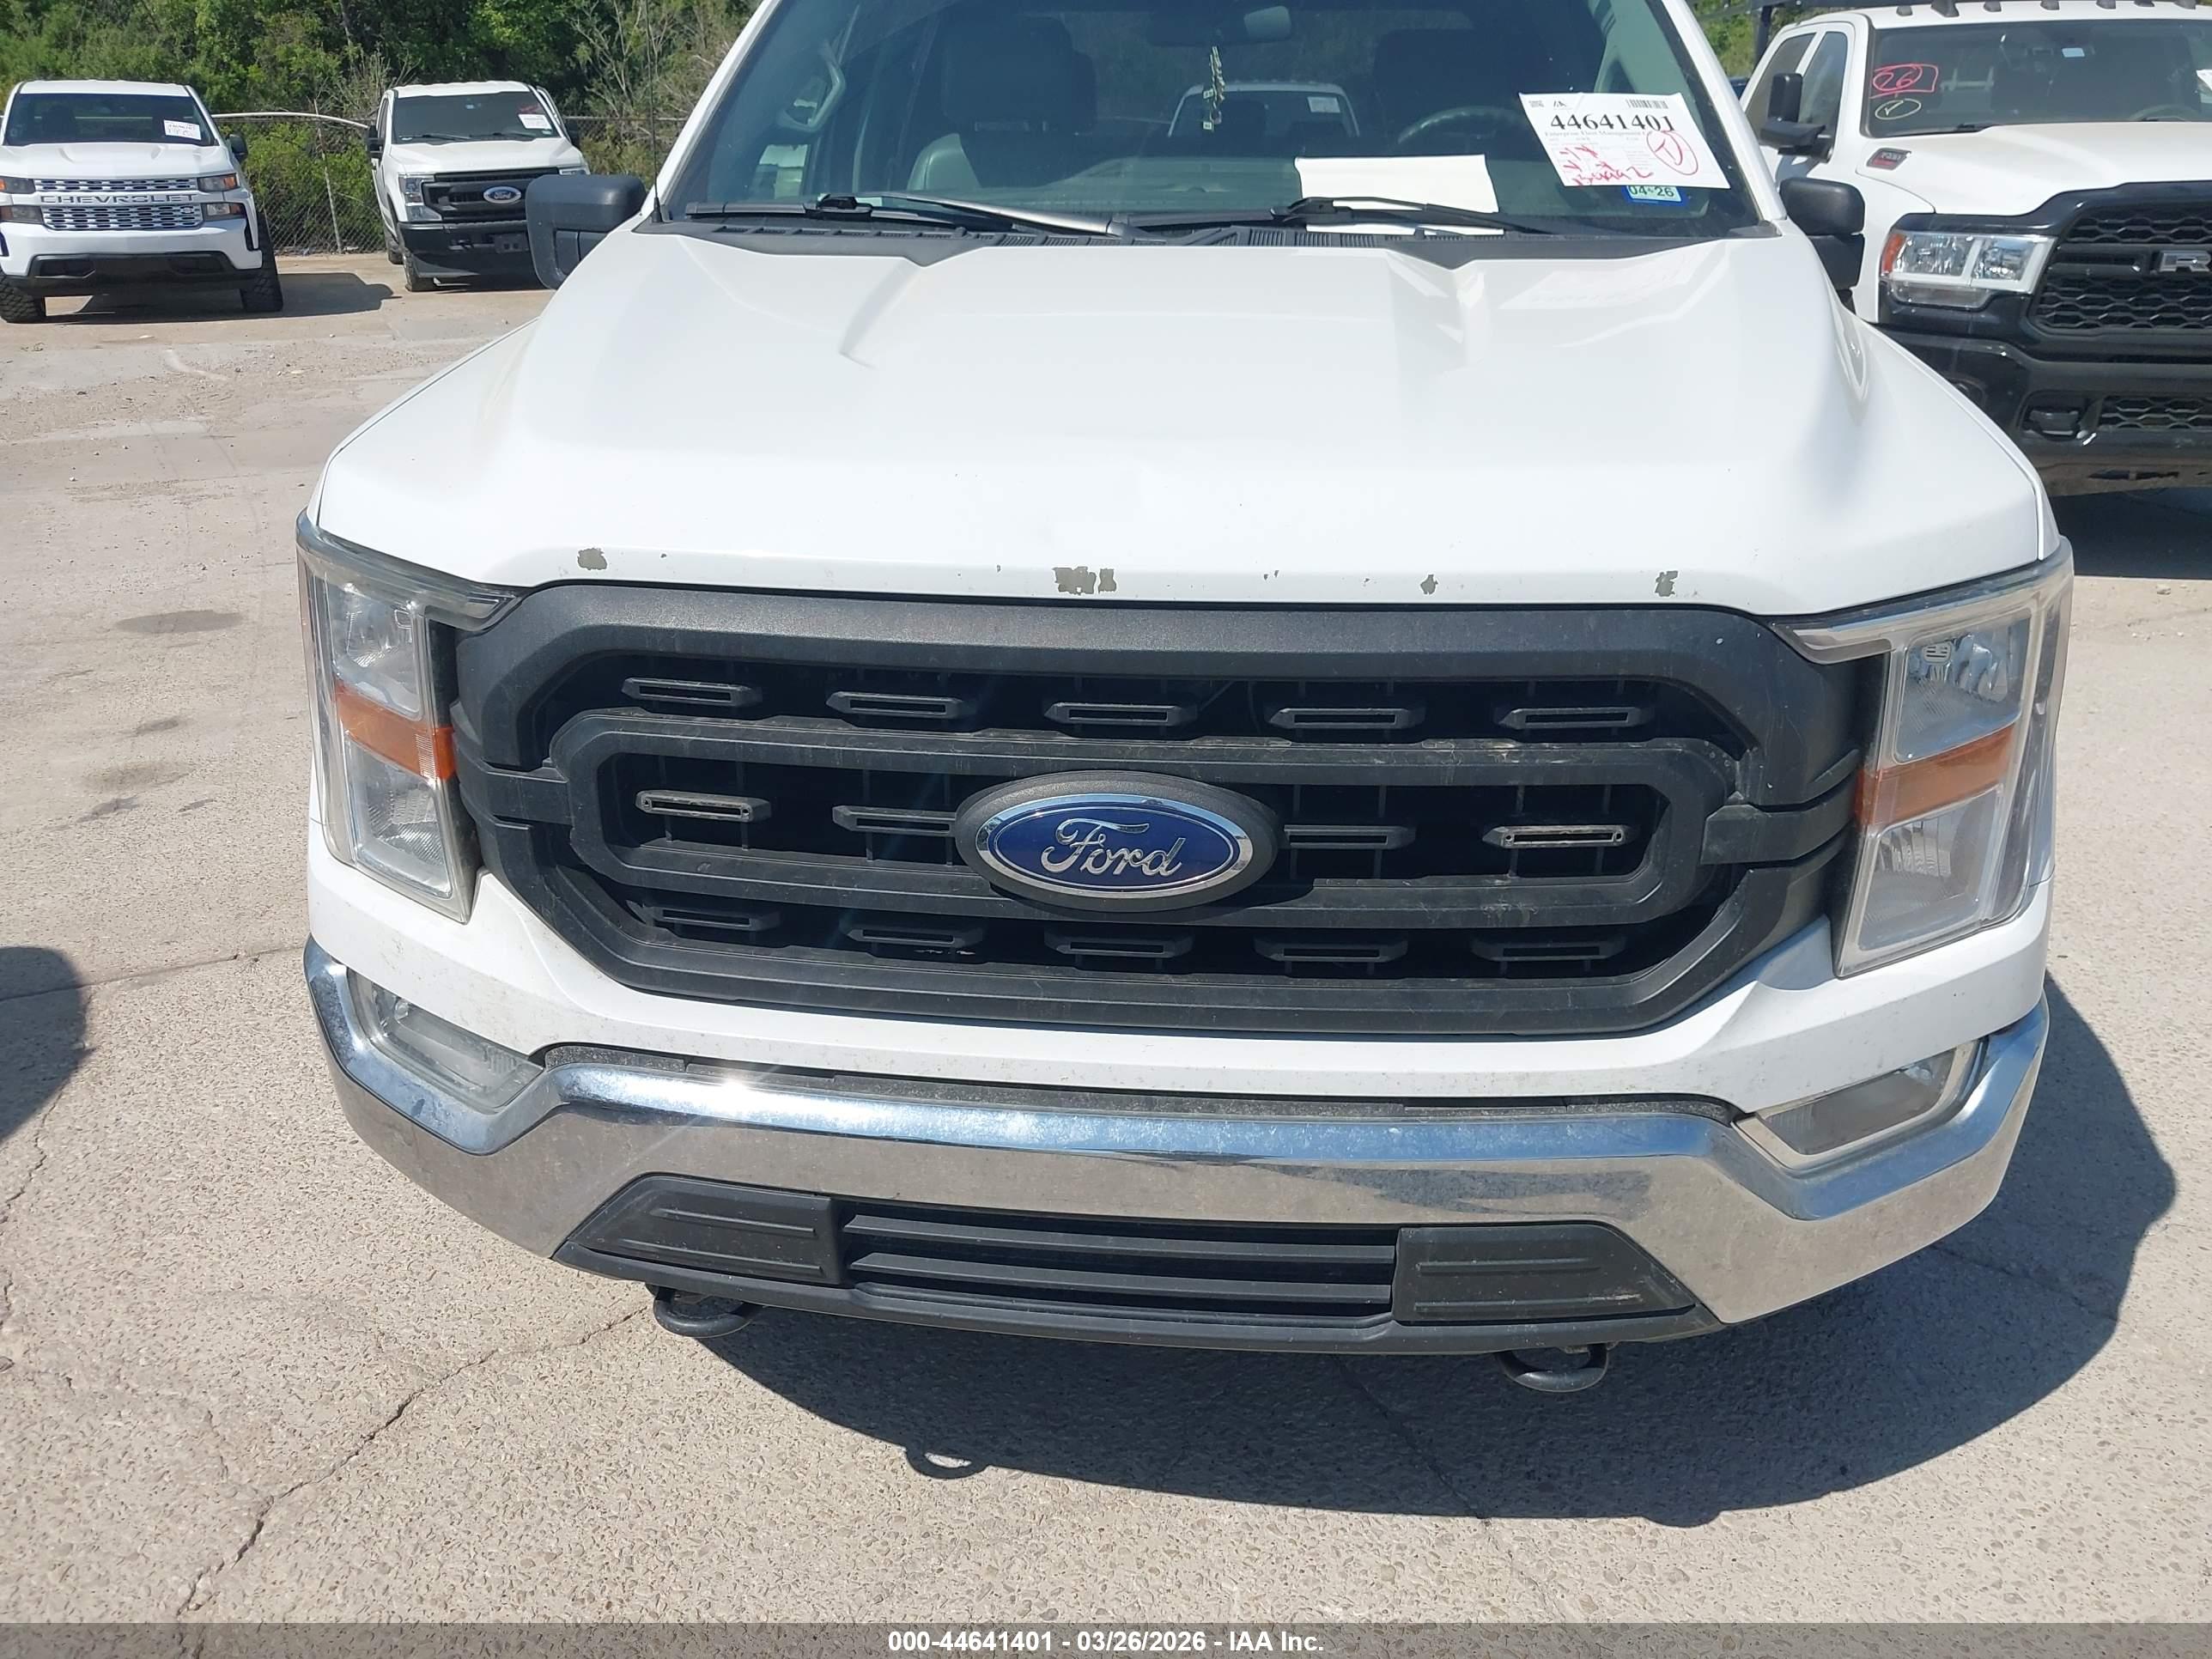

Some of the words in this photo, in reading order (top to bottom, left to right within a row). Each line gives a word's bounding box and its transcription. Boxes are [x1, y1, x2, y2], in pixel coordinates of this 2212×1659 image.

[1551, 113, 1675, 131] 44641401
[40, 194, 198, 204] CHEVROLET
[1041, 817, 1186, 878] Ford
